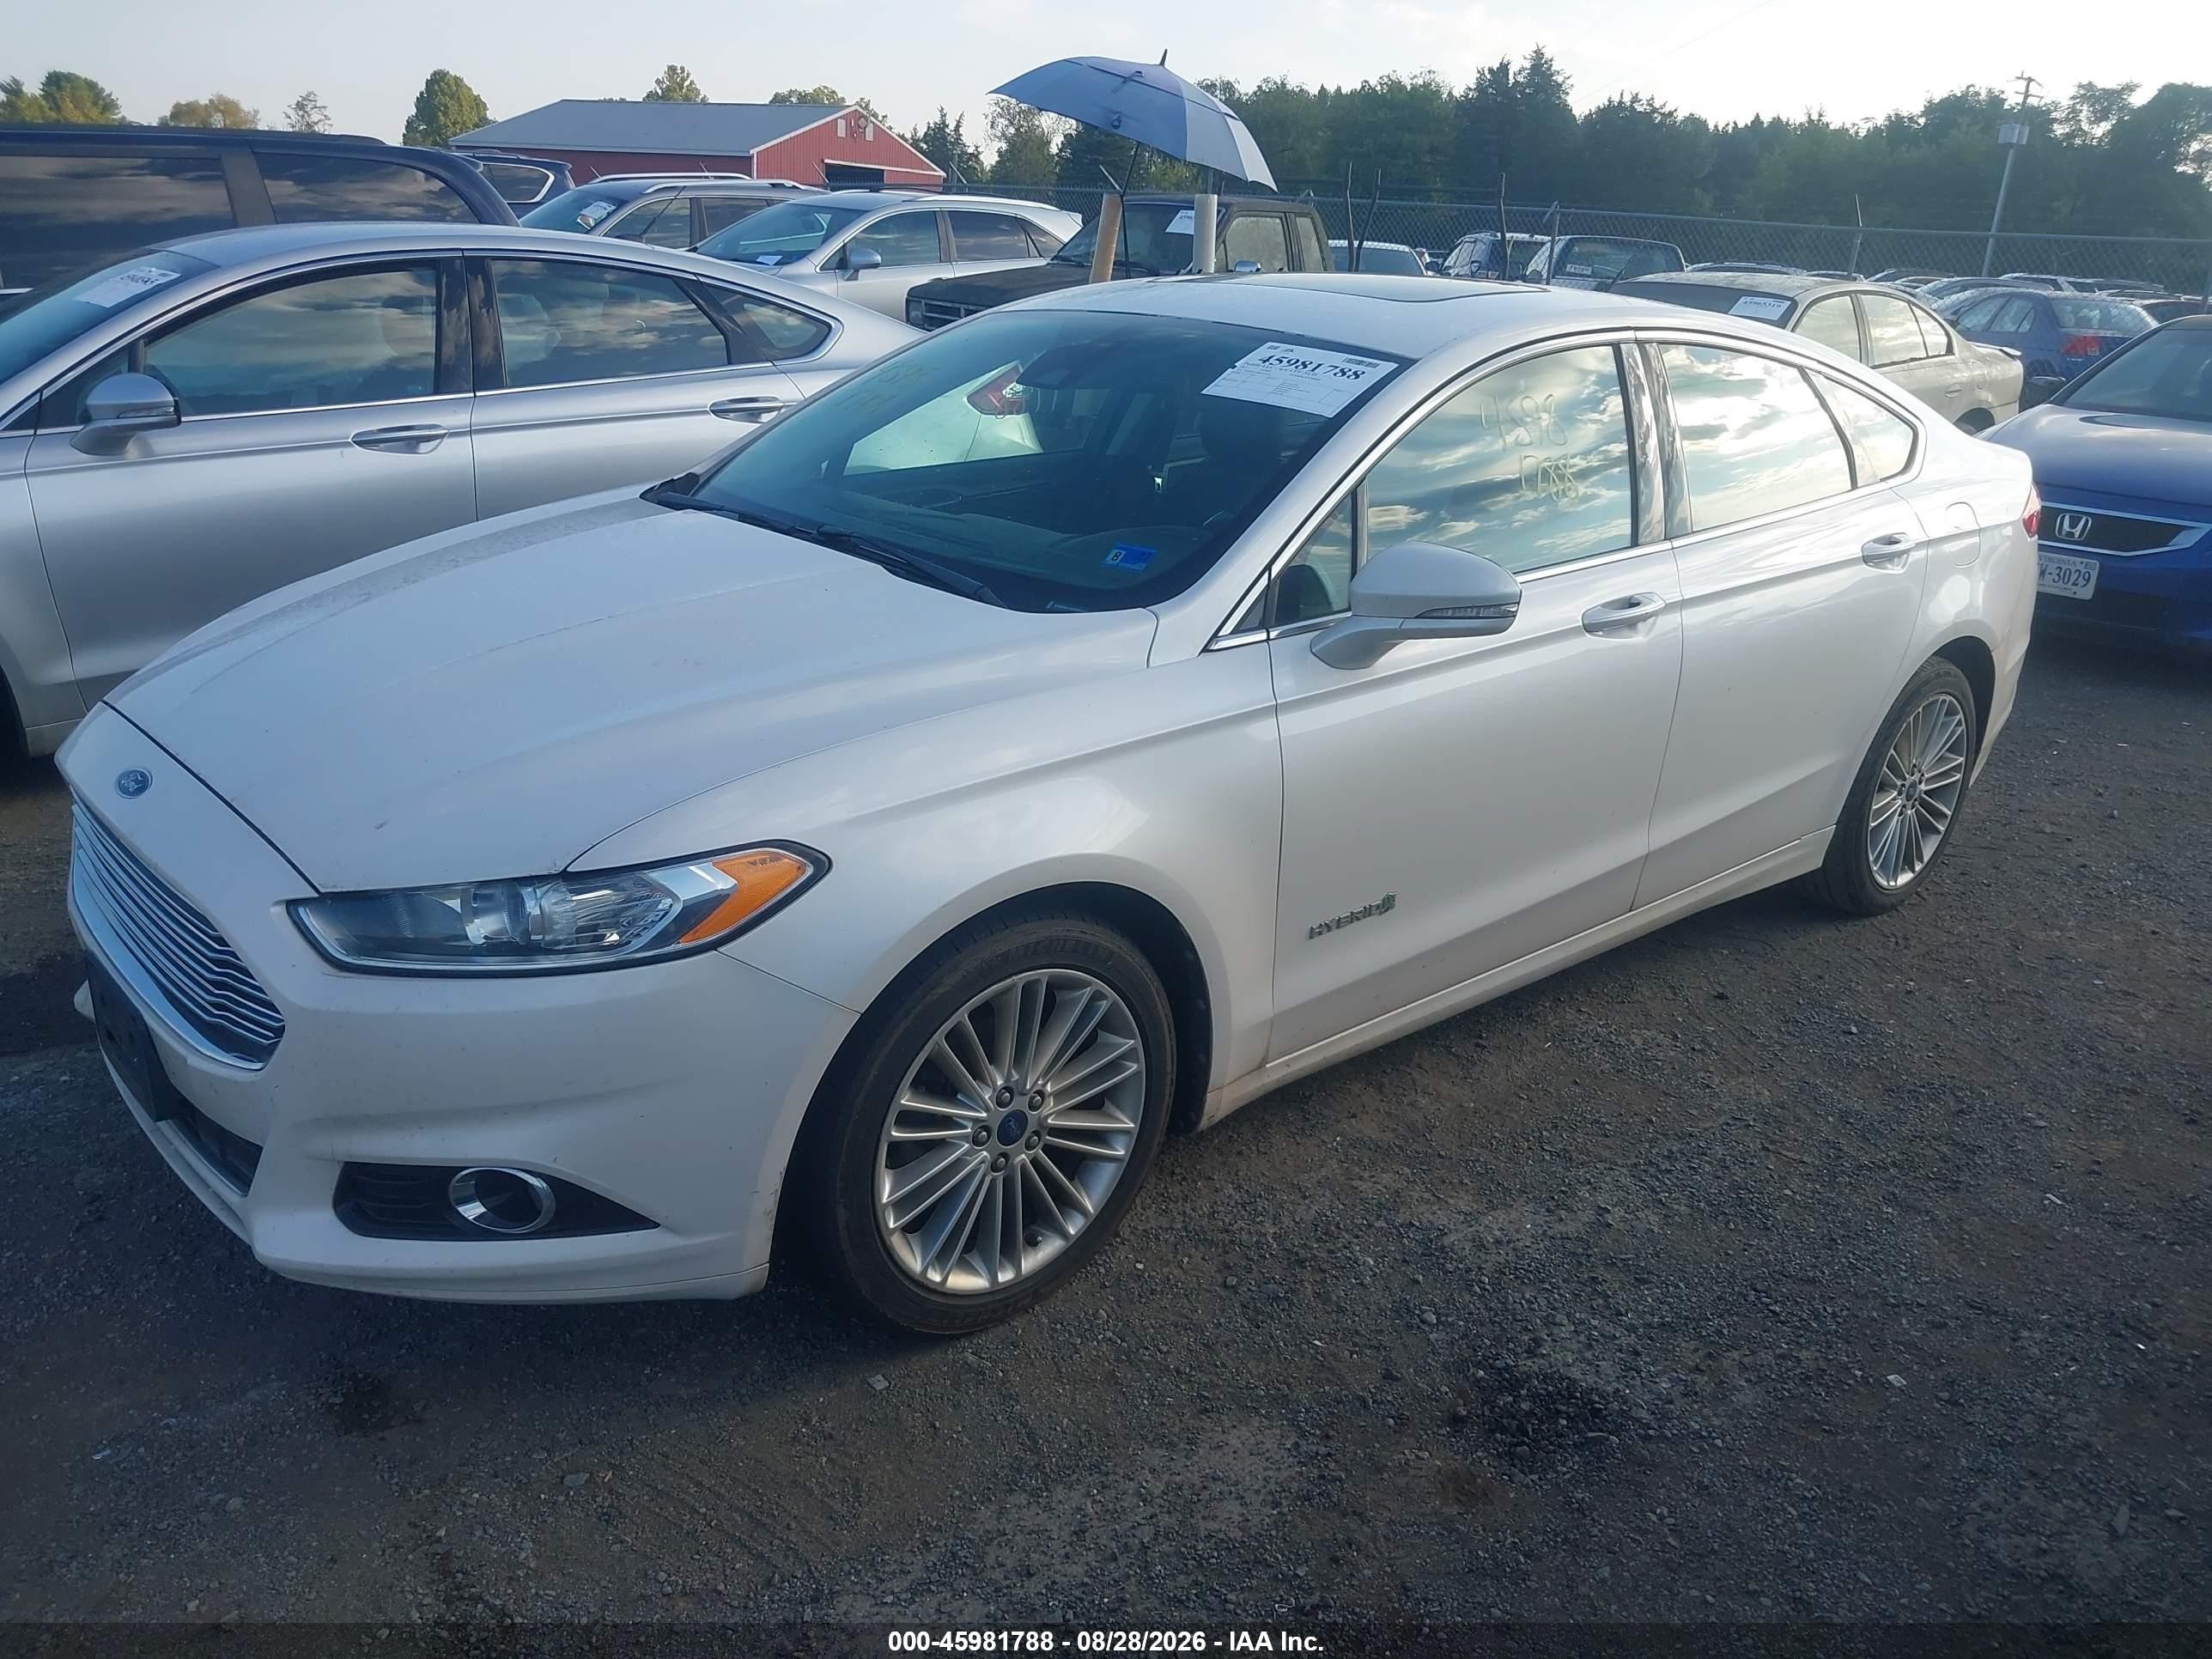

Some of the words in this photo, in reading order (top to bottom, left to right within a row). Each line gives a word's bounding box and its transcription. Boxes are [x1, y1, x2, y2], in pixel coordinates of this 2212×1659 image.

[1257, 354, 1365, 380] 45981788
[1111, 551, 1122, 562] 8
[1308, 899, 1382, 939] HYBRID
